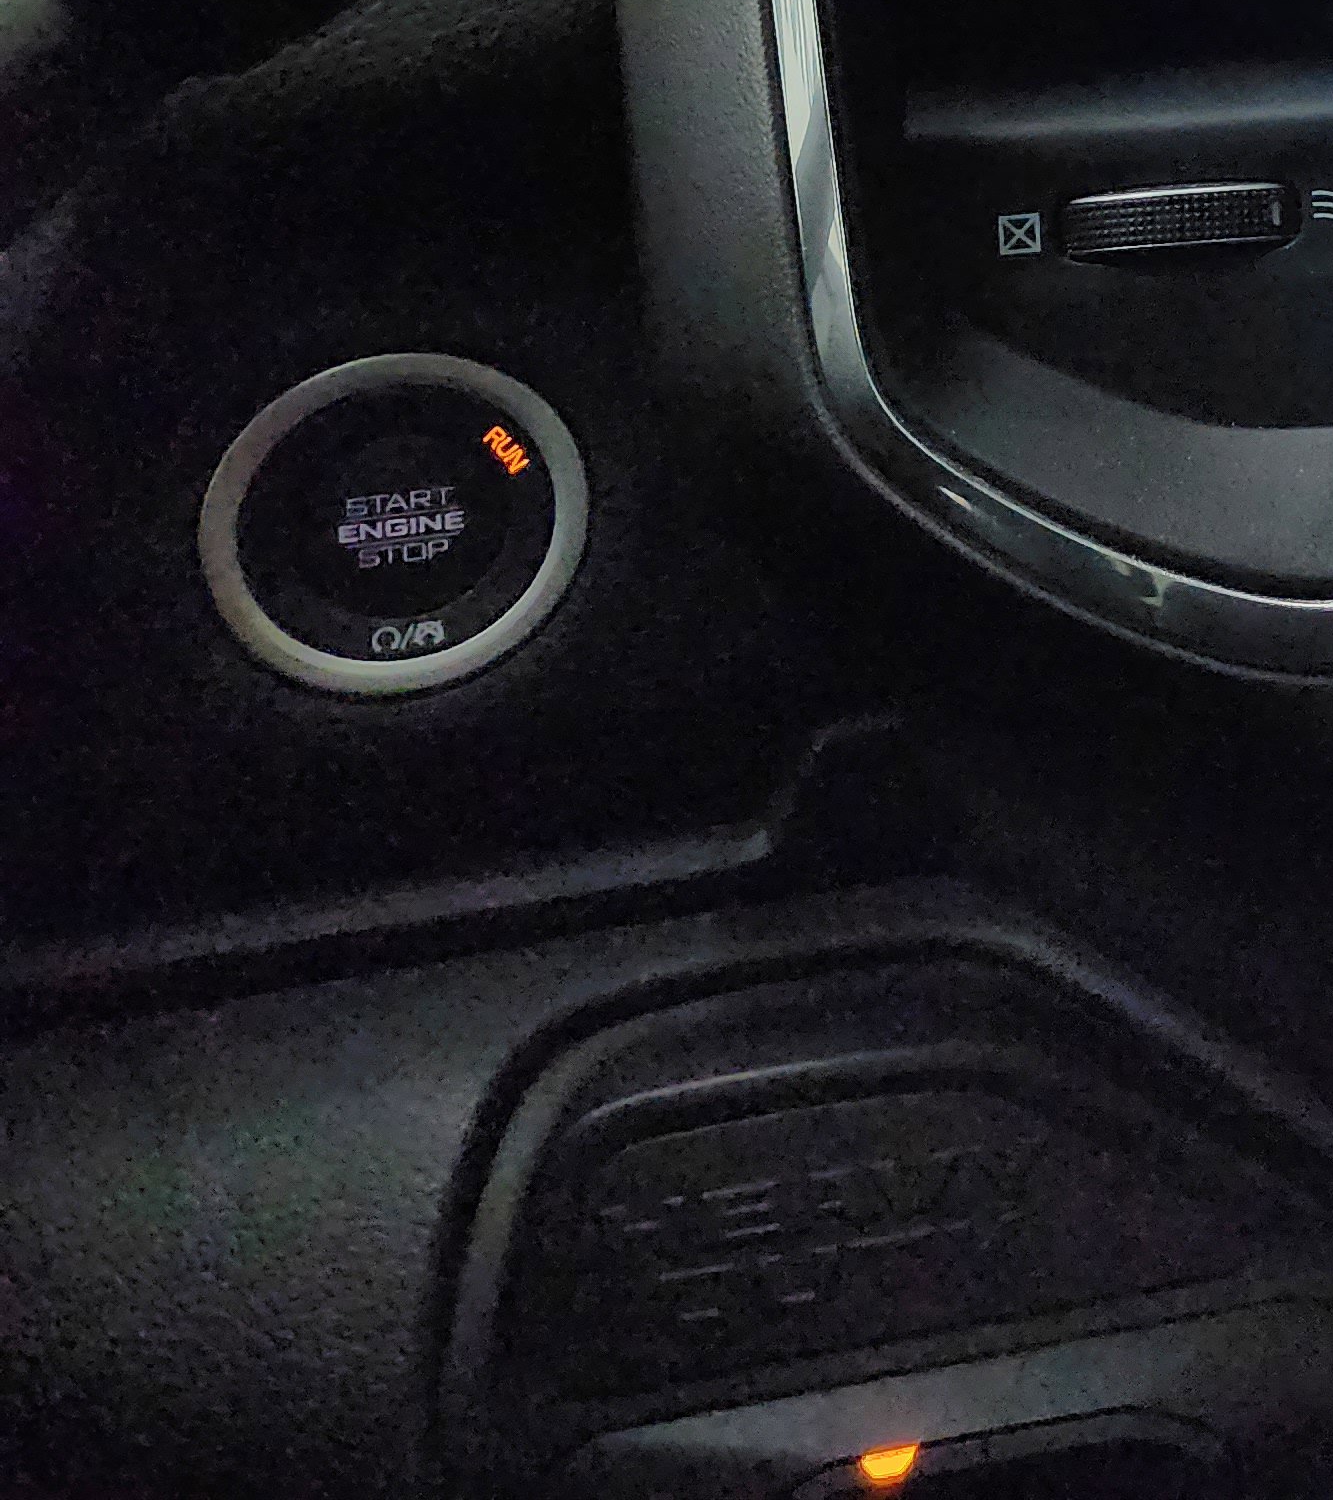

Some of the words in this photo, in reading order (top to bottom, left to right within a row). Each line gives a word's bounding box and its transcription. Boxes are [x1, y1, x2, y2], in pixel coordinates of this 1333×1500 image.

[481, 425, 531, 476] RUN
[345, 485, 456, 517] START
[337, 510, 466, 545] ENGINE
[357, 537, 450, 569] STOP
